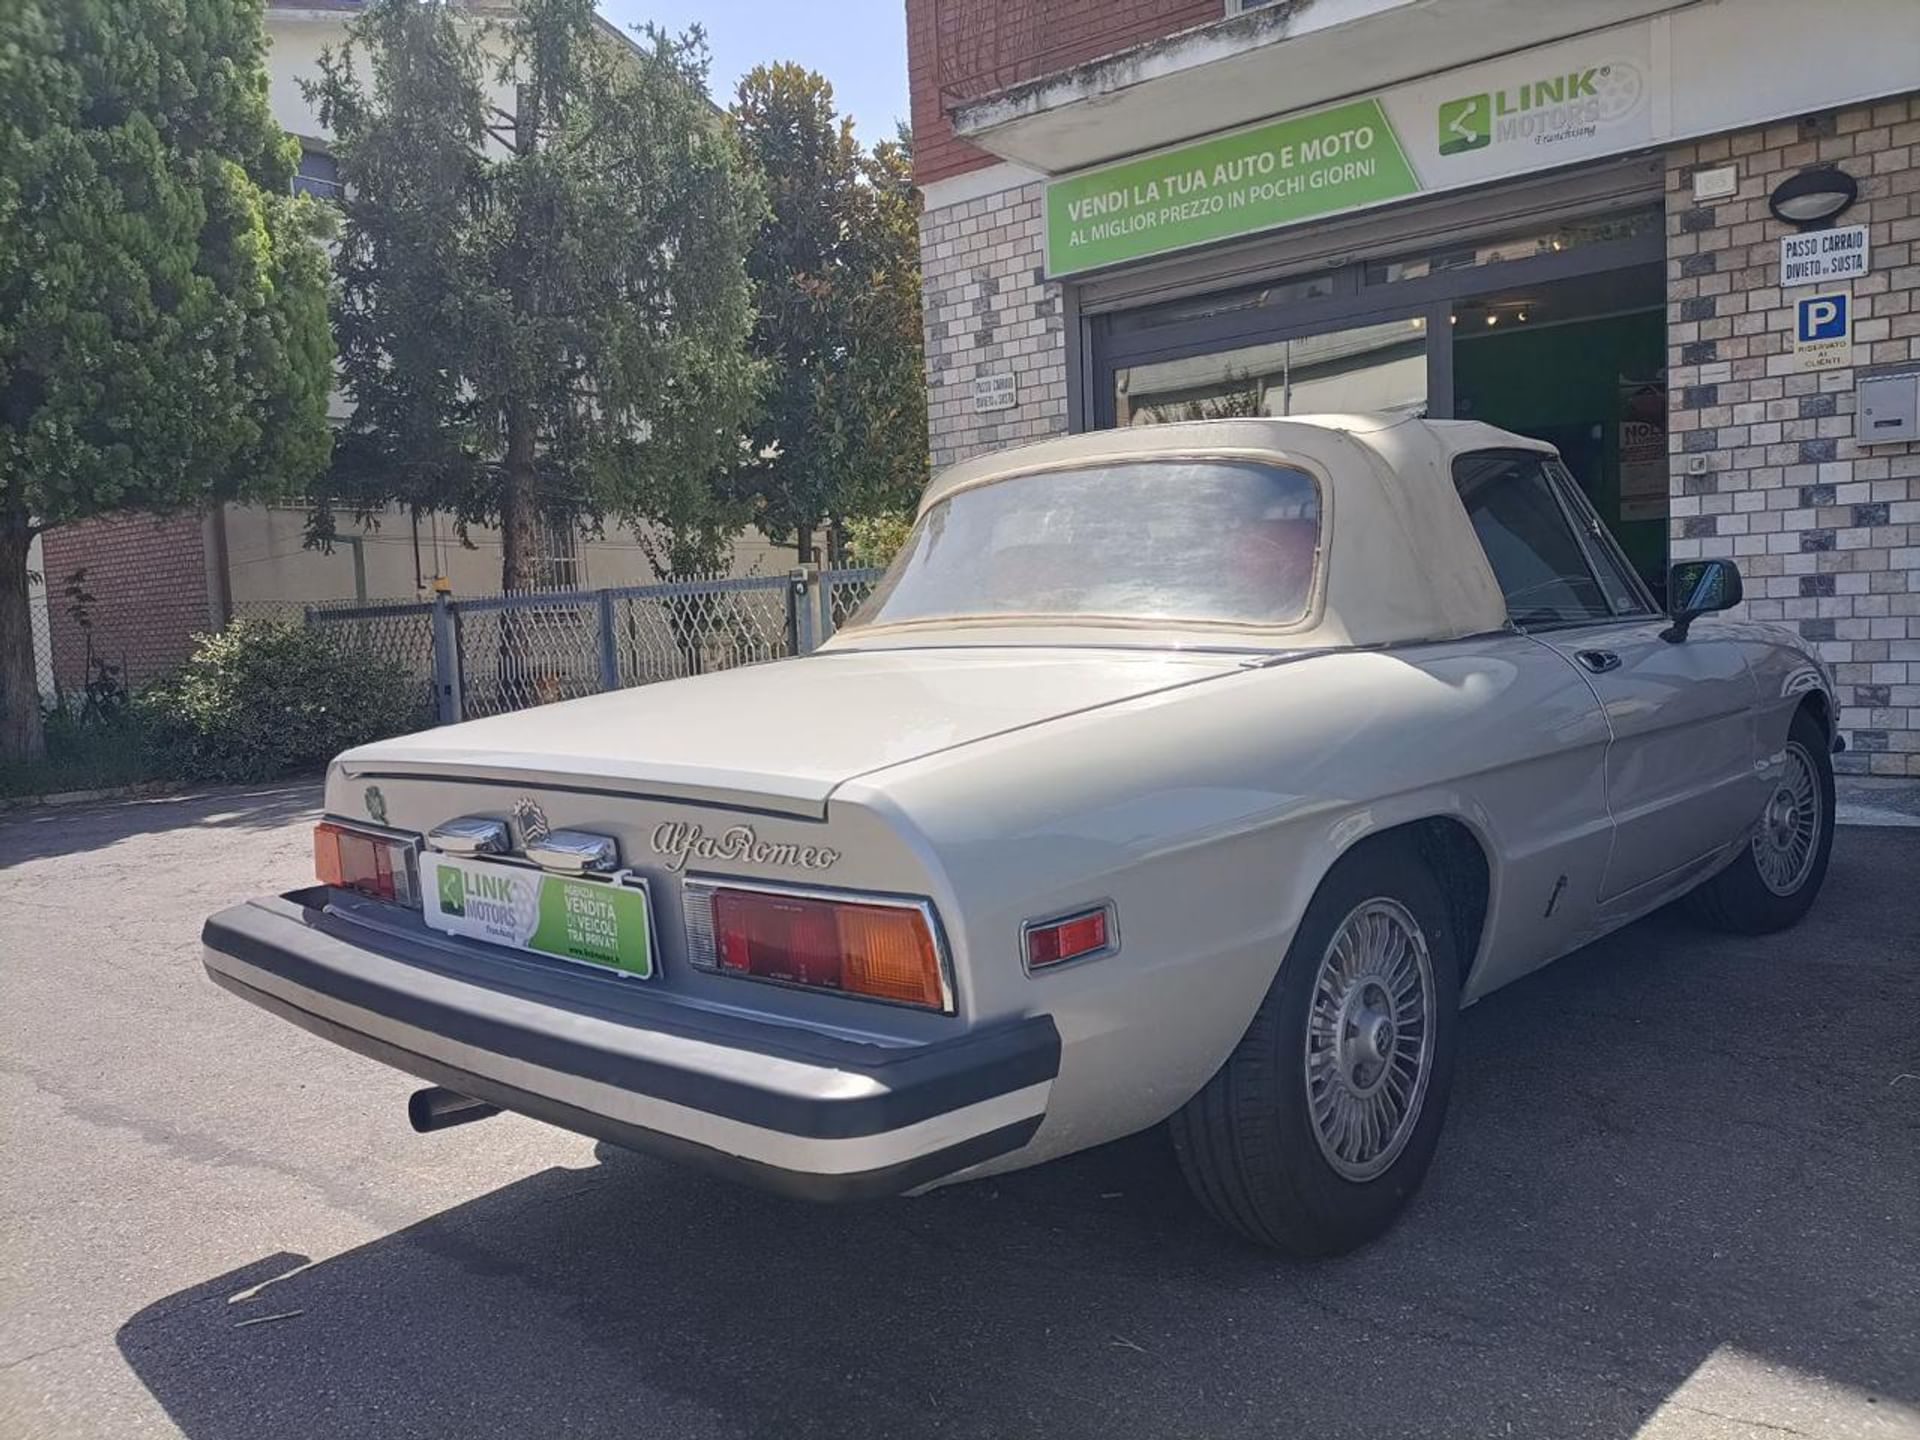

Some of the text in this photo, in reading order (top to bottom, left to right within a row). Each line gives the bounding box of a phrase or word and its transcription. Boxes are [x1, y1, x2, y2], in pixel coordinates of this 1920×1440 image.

[1496, 100, 1600, 143] MOTORS
[1068, 126, 1374, 222] VENDI LA TUA AUTO E MOTO
[1069, 158, 1376, 247] AL MIGLIOR PREZZO IN POCHI GIORNI
[1786, 231, 1863, 259] PASSO CARRAIO
[1786, 259, 1821, 280] DIVIETO
[1831, 254, 1863, 273] SOSTA
[1807, 301, 1838, 337] P
[1798, 341, 1847, 354] RISERVATO
[651, 822, 841, 872] Alfa Romeo
[465, 899, 517, 928] MOTORS
[564, 896, 617, 922] VENDITA
[567, 928, 619, 951] TRA PRIVATI
[577, 916, 618, 938] VEICOLI
